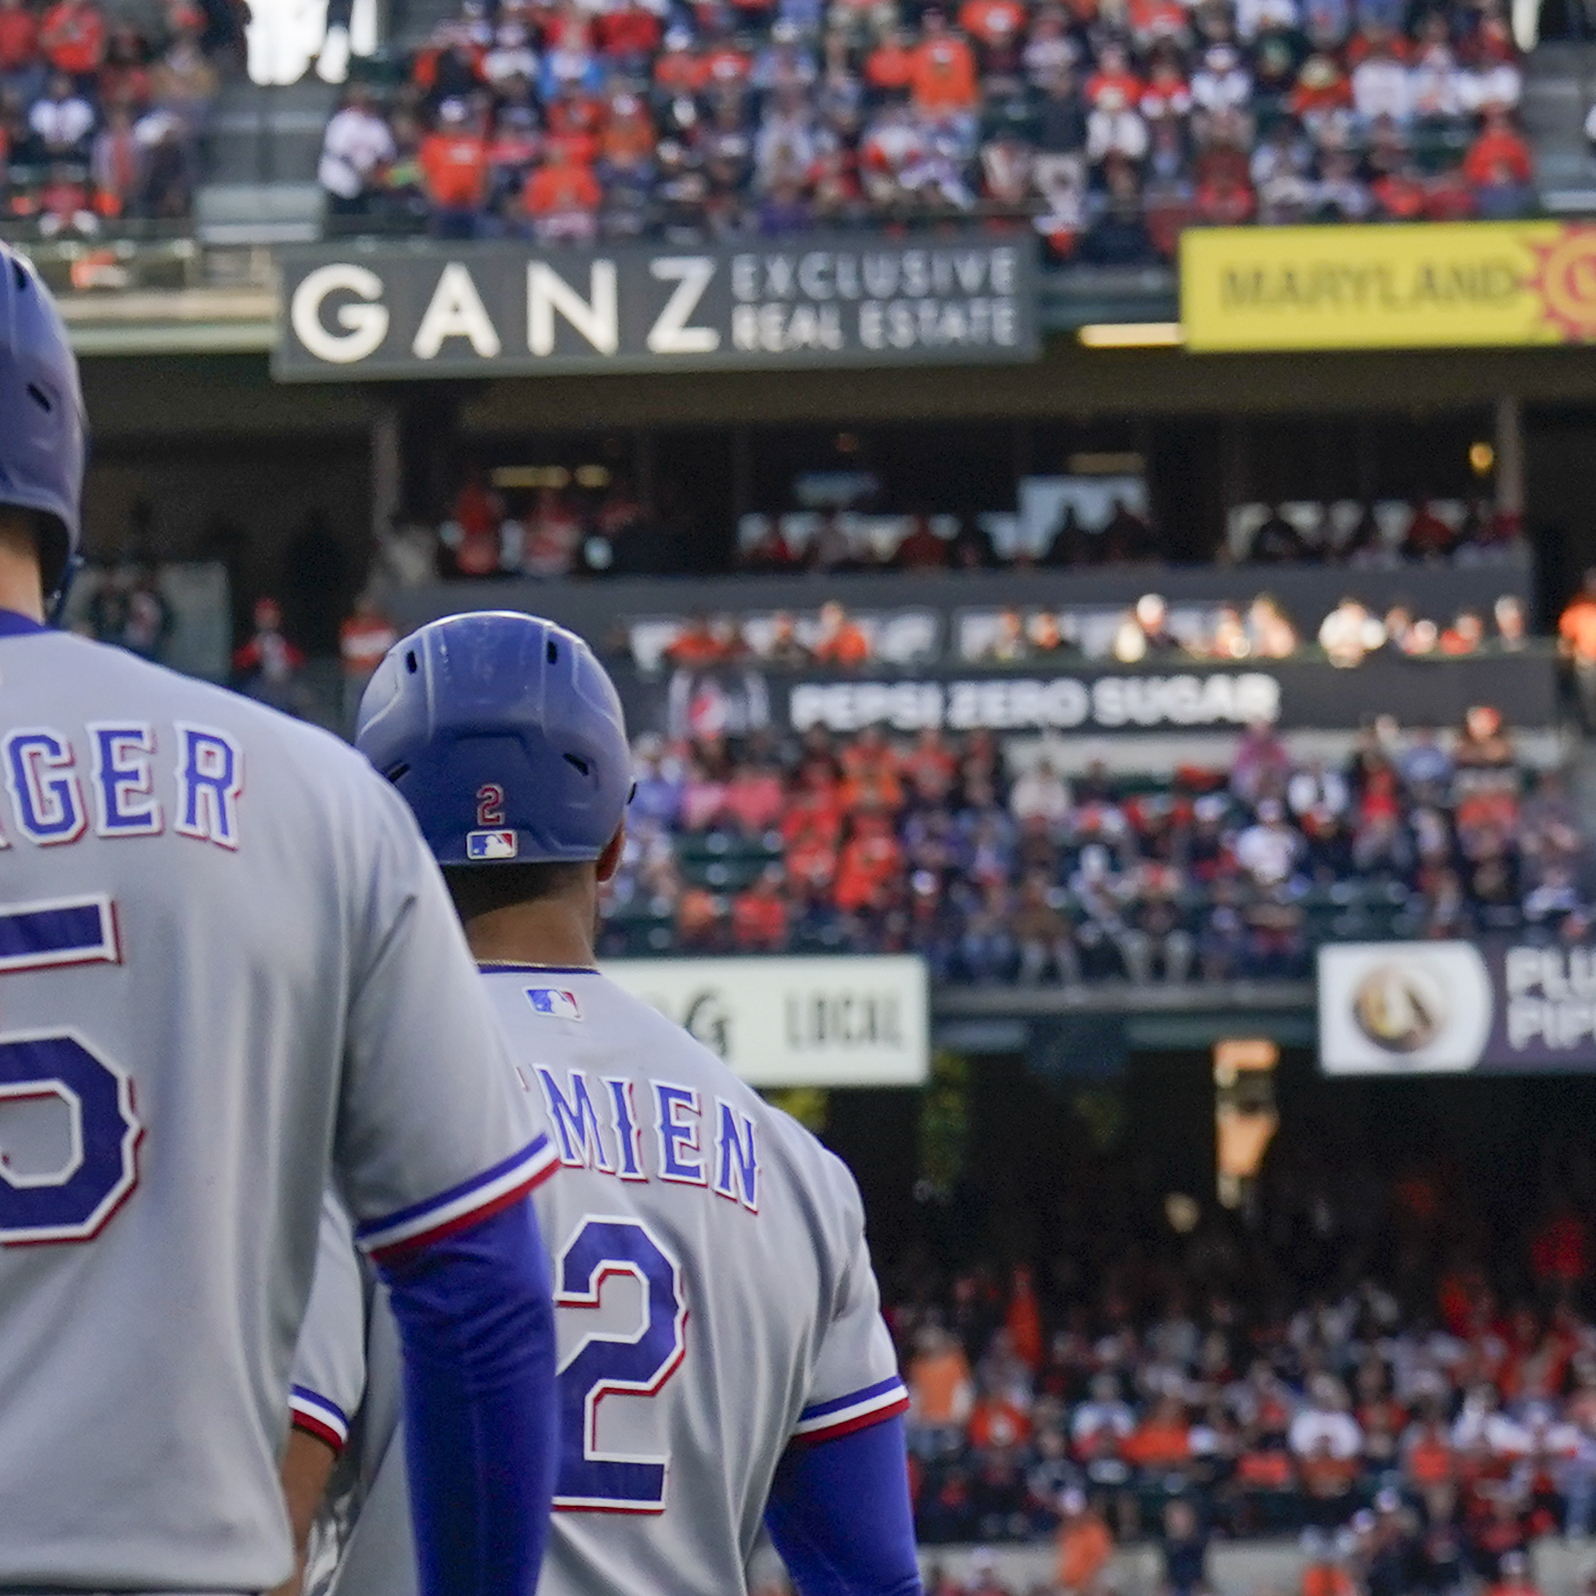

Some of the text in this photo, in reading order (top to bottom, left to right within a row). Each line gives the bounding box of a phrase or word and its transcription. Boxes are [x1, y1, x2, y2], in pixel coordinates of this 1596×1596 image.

[732, 247, 1019, 301] EXCLUSIVE
[1220, 254, 1518, 314] MARYLAND
[290, 256, 721, 364] GANZ
[731, 296, 1019, 352] REAL ESTATE
[791, 673, 1282, 732] PEPSI ZERO SUGAR
[476, 784, 506, 826] 2
[784, 988, 903, 1050] LOCAL
[551, 1213, 690, 1515] 2
